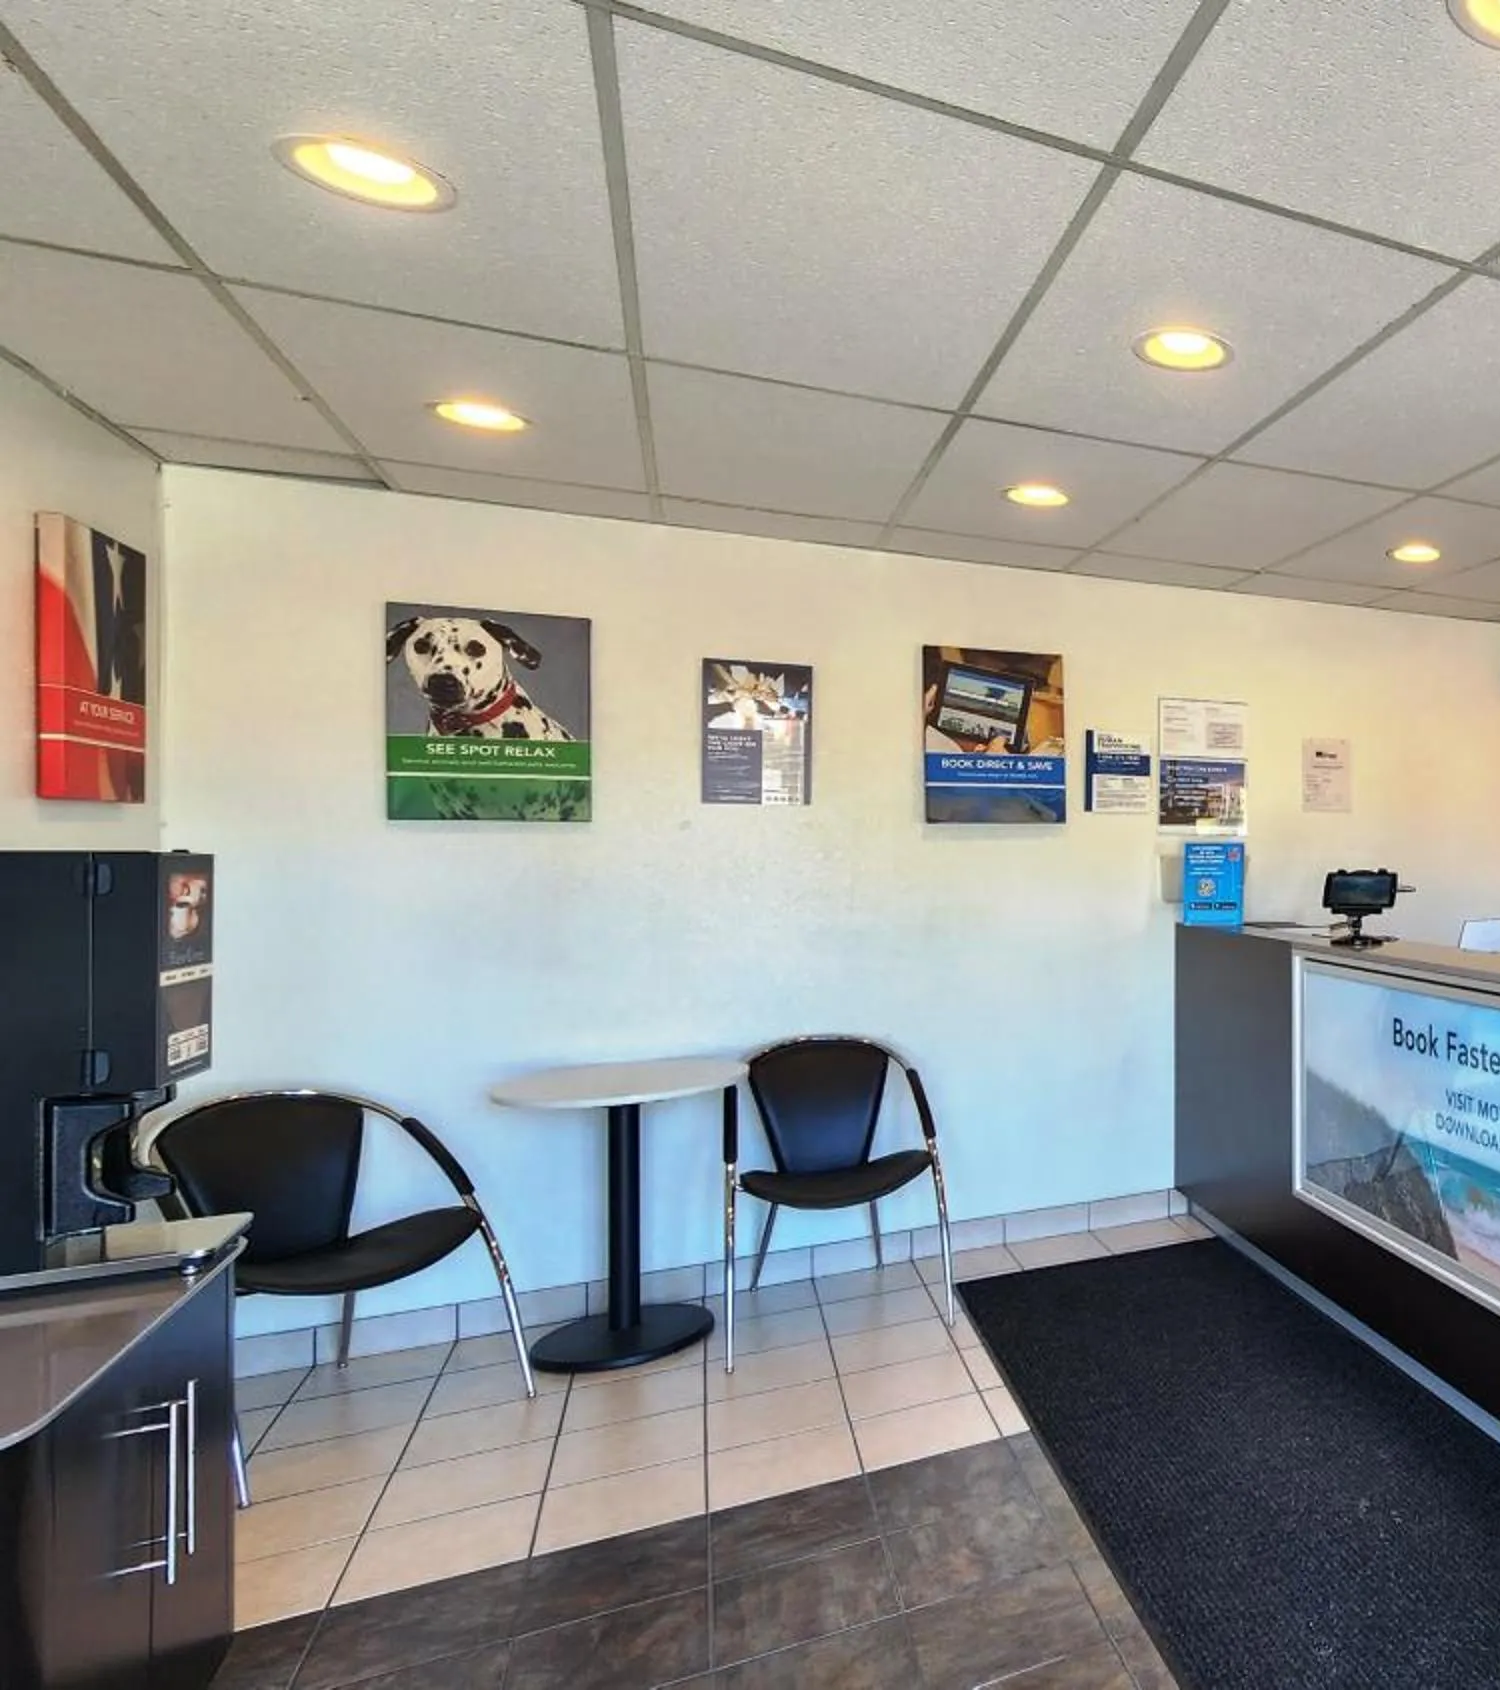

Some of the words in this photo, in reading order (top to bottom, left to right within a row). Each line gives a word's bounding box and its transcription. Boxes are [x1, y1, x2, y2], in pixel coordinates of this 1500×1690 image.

[425, 743, 455, 755] SEE
[460, 744, 500, 757] SPOT
[504, 745, 557, 758] RELAX
[941, 758, 973, 769] BOOK
[975, 760, 1014, 770] DIRECT
[1016, 761, 1025, 770] &
[1027, 761, 1053, 771] SAVE
[1393, 1017, 1438, 1059] Book
[1446, 1088, 1473, 1113] VISIT
